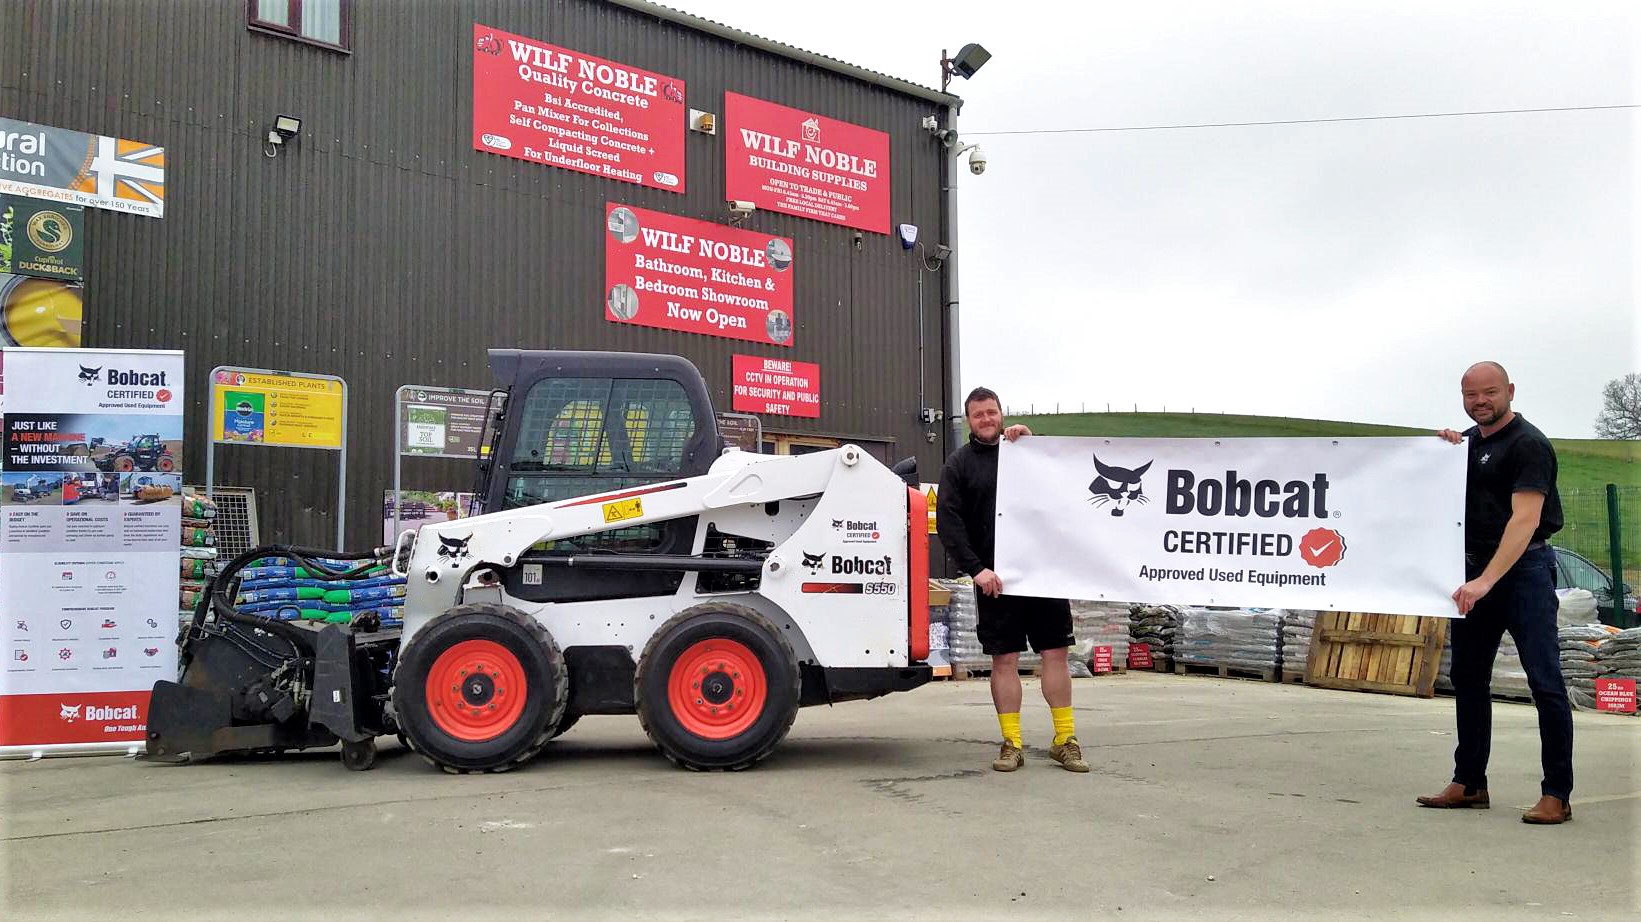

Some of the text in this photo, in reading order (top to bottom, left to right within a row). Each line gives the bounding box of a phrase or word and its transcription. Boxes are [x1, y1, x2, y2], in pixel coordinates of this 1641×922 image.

[508, 40, 657, 97] WILF NOBLE
[519, 65, 648, 108] Quality Concrete
[514, 100, 648, 141] Pan Mixer For Collections
[545, 94, 624, 123] Bsi Accredited,
[510, 115, 530, 127] Self
[533, 119, 598, 144] Compacting
[601, 136, 646, 154] Concrete
[549, 138, 620, 162] Liquid Screed
[740, 128, 876, 178] WILF NOBLE
[0, 151, 45, 176] tion
[524, 147, 542, 159] For
[544, 152, 600, 172] Underfloor
[603, 163, 642, 183] Heating
[749, 155, 867, 191] BUILDING SUPPLIES
[16, 186, 74, 201] AGGREGATES
[89, 198, 109, 206] over
[127, 203, 149, 212] Years
[770, 178, 788, 188] OPEN
[800, 185, 822, 196] TRADE
[829, 192, 852, 202] PUBLIC
[641, 227, 765, 268] WILF NOBLE
[19, 261, 77, 275] DUCKSBACK
[635, 254, 775, 291] Bathroom, Kitchen &
[635, 275, 769, 310] Bedroom Showroom
[667, 302, 746, 329] Now Open
[108, 368, 166, 387] Bobcat
[764, 360, 791, 371] BEWARE!
[248, 377, 325, 390] ESTABLISHED PLANTS
[746, 372, 808, 388] CCTV IN OPERATION
[107, 390, 154, 399] CERTIFIED
[428, 394, 456, 402] IMPROVE
[471, 397, 485, 405] SOIL
[734, 385, 819, 403] FOR SECURITY AND PUBLIC
[765, 403, 790, 414] SAFETY
[12, 421, 57, 430] JUST LIKE
[12, 433, 18, 441] A
[21, 433, 41, 441] NEW
[11, 456, 88, 464] THE INVESTMENT
[20, 444, 60, 453] WITHOUT
[1165, 469, 1330, 519] Bobcat
[847, 521, 877, 530] Bobcat
[1163, 530, 1293, 557] CERTIFIED
[832, 555, 892, 575] Bobcat
[1139, 564, 1326, 588] Approved Used Equipment
[524, 572, 536, 583] 101
[865, 582, 896, 595] S550
[85, 705, 137, 721] Bobcat
